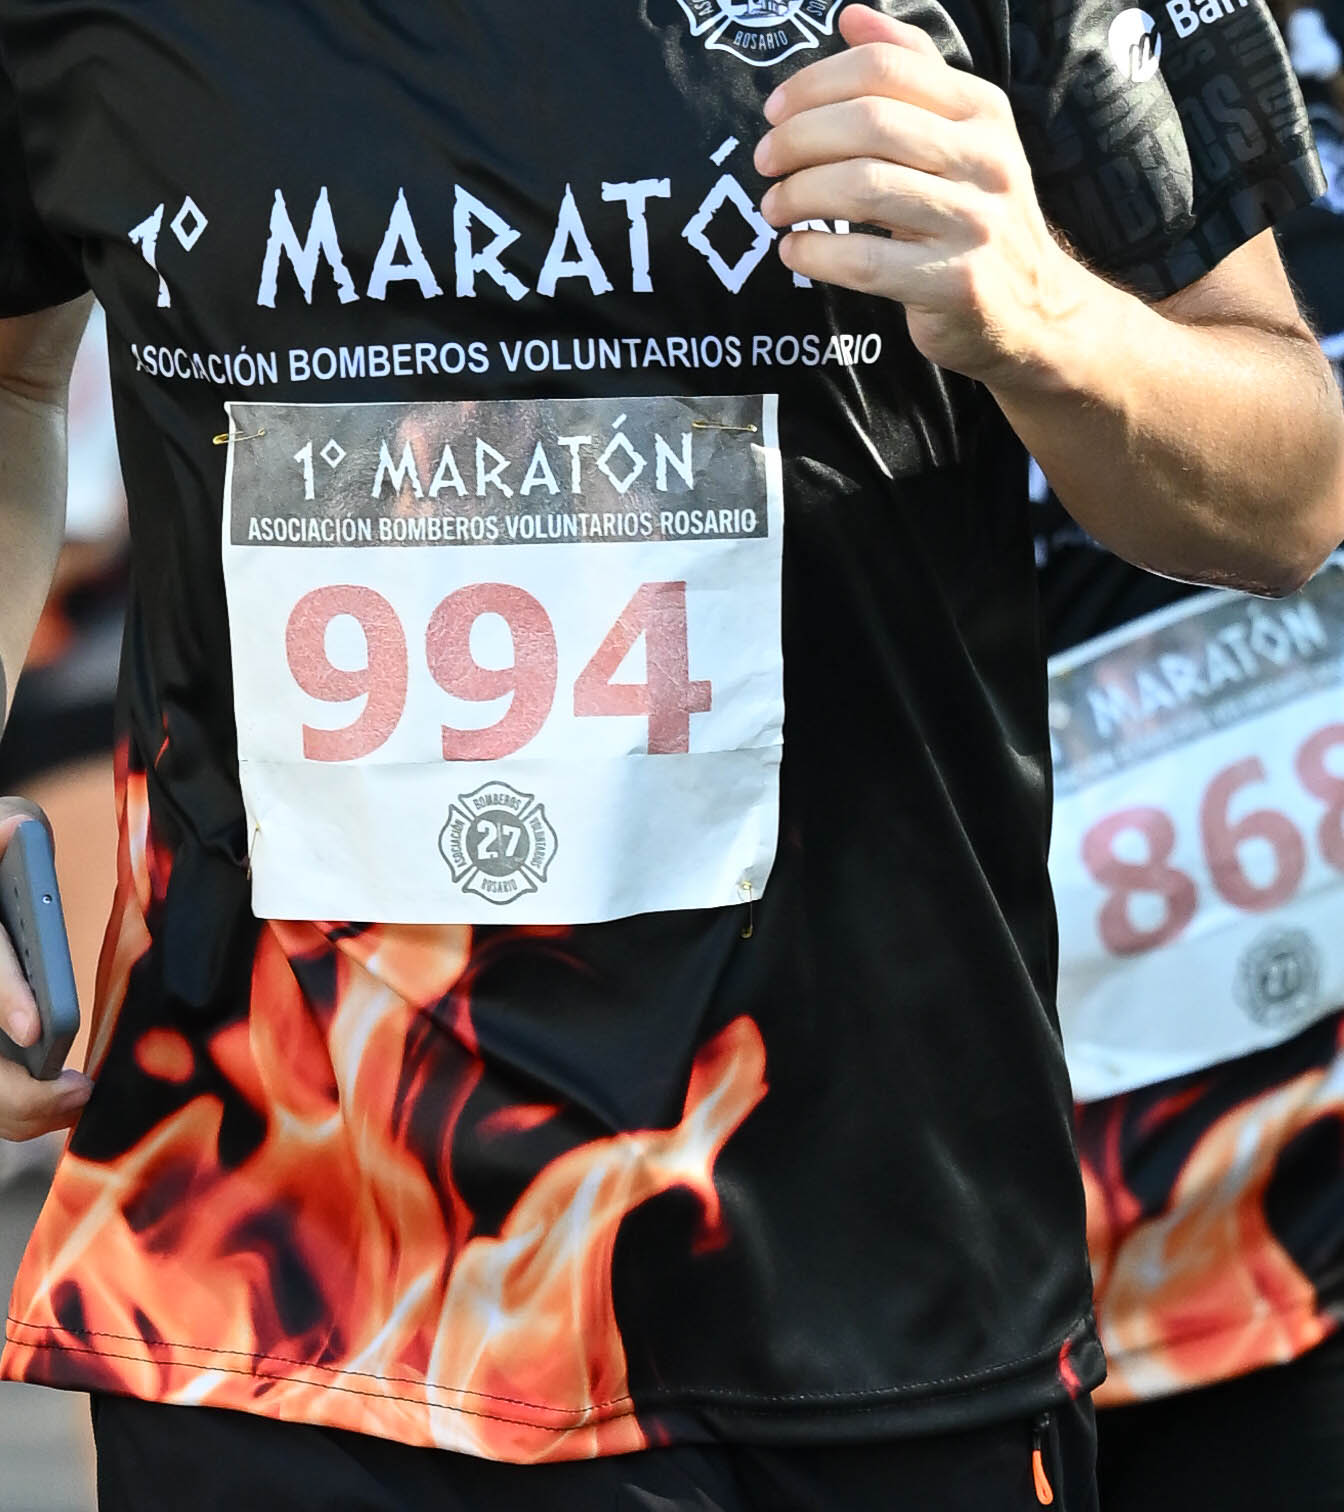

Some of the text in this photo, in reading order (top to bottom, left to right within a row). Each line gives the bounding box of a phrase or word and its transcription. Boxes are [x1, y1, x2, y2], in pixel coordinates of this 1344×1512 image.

[733, 31, 788, 50] ROSARIO
[257, 136, 850, 308] MARATÓ
[288, 342, 490, 382] BOMBEROS
[500, 335, 742, 373] VOLUNTARIOS
[753, 333, 883, 367] ROSARIO
[370, 413, 695, 499] MARATÓN
[248, 508, 757, 542] ASOCIACIÓN BOMBEROS VOLUNTARIOS ROSARIO
[286, 581, 712, 762] 994
[476, 819, 522, 860] 27
